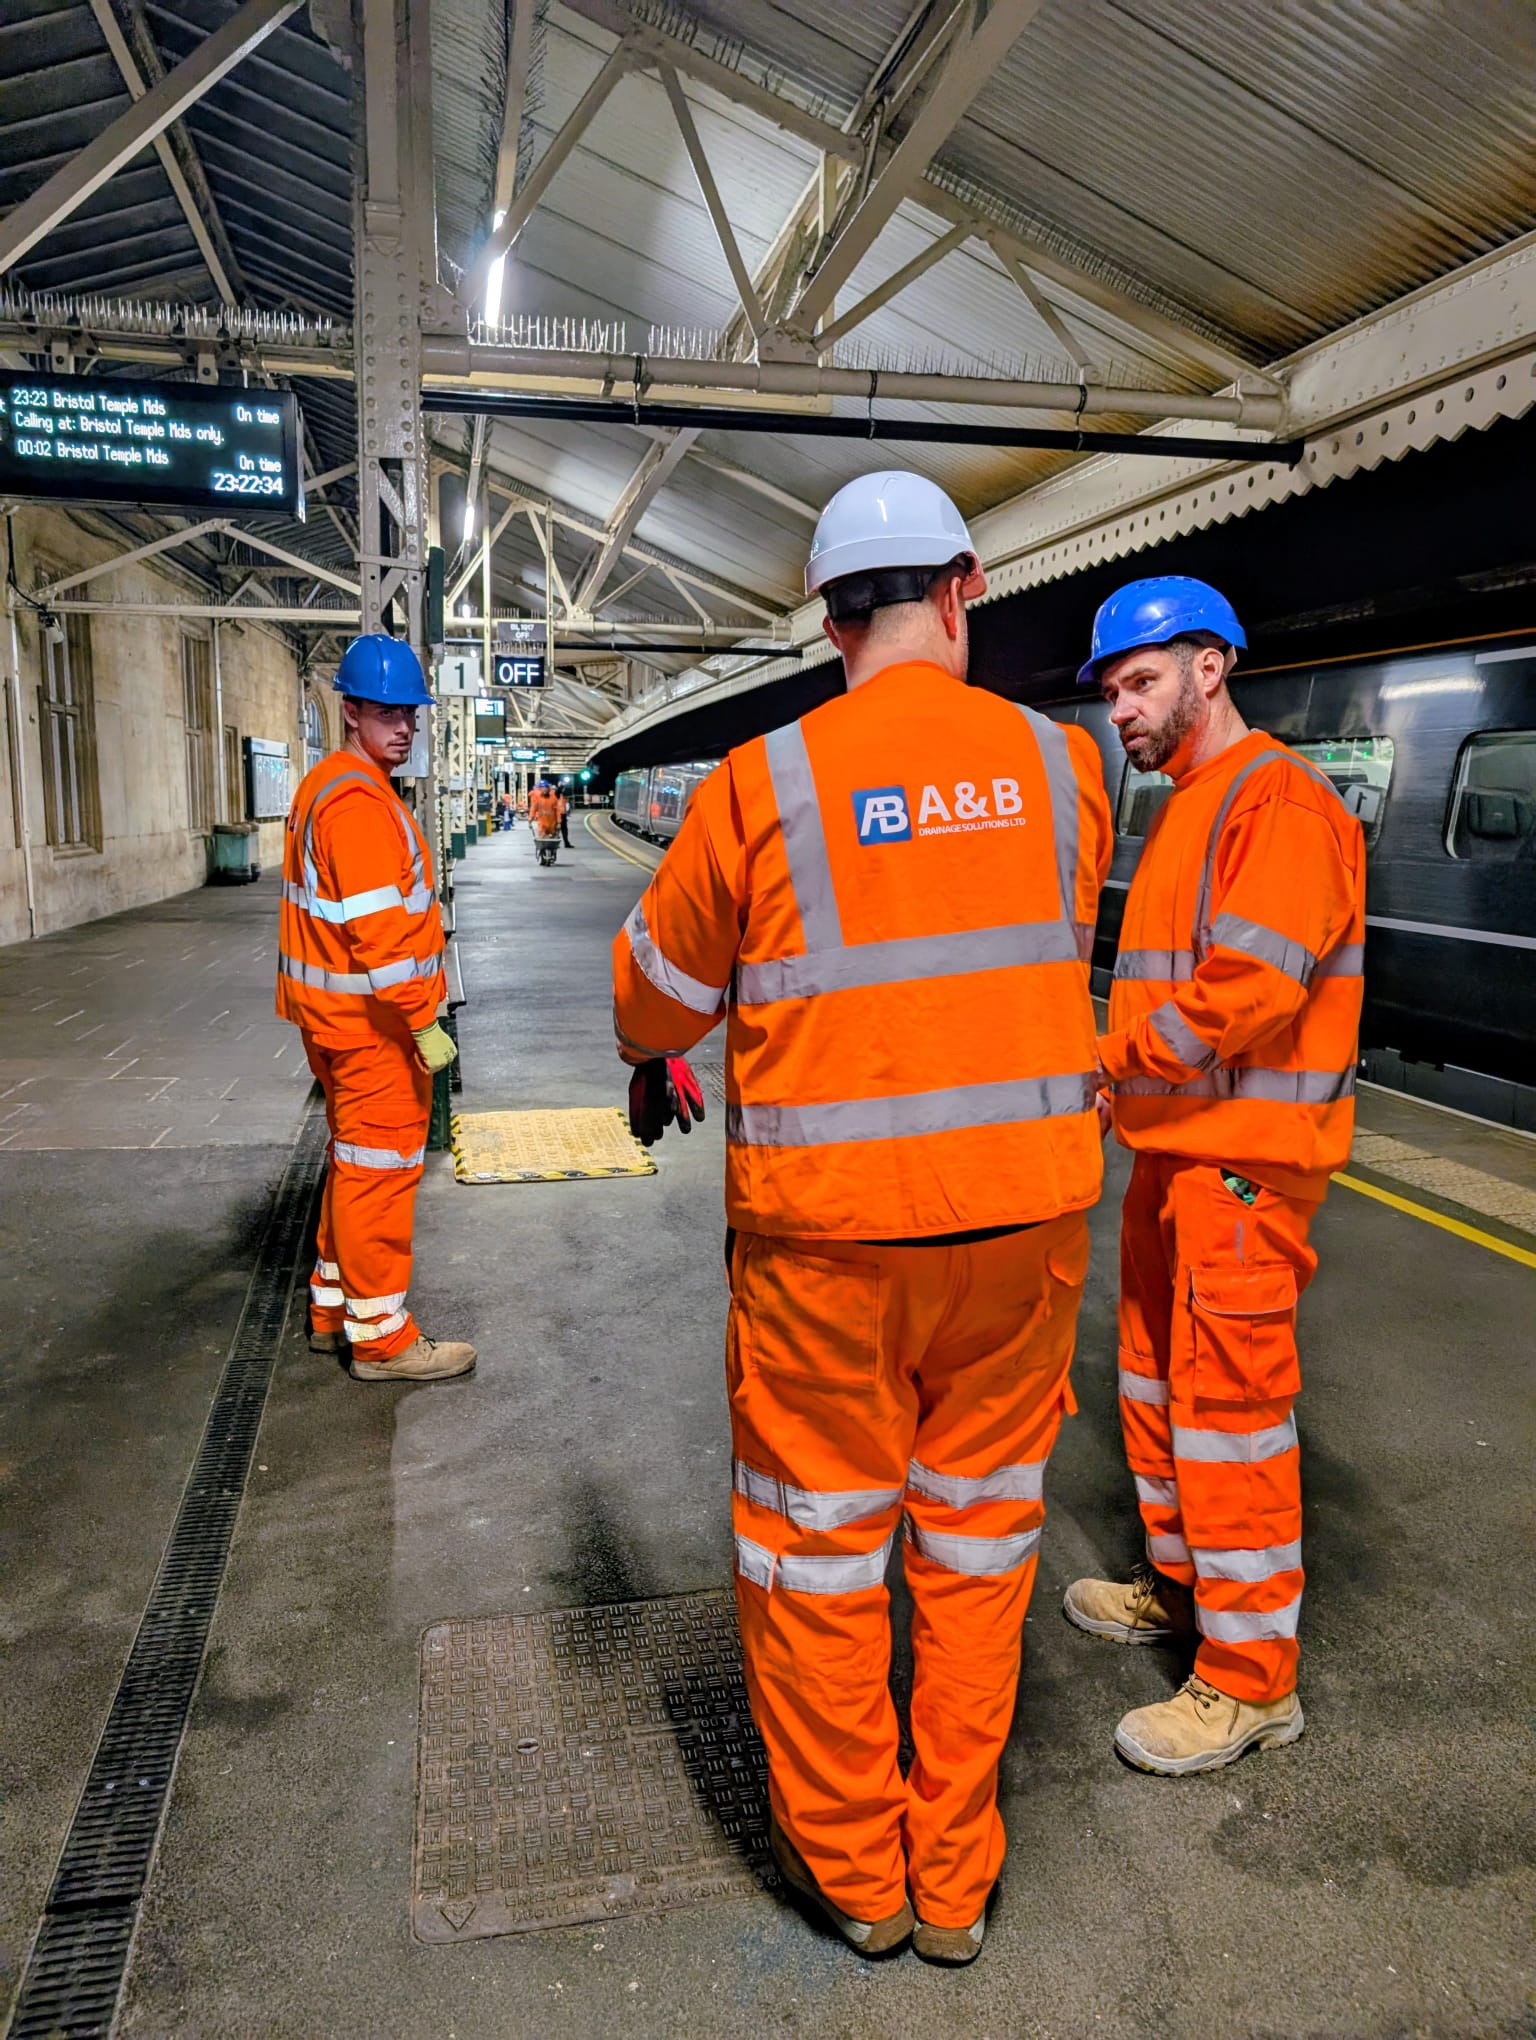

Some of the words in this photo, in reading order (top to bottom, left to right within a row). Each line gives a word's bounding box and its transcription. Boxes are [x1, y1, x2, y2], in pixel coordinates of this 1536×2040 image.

[13, 389, 47, 407] 23:23
[53, 393, 95, 411] Bristol
[100, 397, 138, 416] Temple
[143, 399, 167, 416] Mds
[237, 407, 254, 423] On
[258, 409, 280, 425] time
[15, 411, 53, 433] Calling
[58, 418, 76, 431] at:
[80, 416, 121, 435] Bristol
[126, 420, 165, 440] Temple
[169, 422, 192, 440] Mds
[196, 425, 225, 446] only.
[18, 439, 52, 457] 00:02
[57, 443, 99, 461] Bristol
[103, 446, 142, 466] Temple
[146, 447, 169, 465] Mds
[239, 455, 254, 471] On
[259, 457, 281, 473] time
[214, 473, 284, 495] 23:22:34
[454, 662, 465, 689] 1
[498, 662, 539, 684] OFF
[918, 825, 961, 837] DRAINAGE
[961, 819, 1009, 832] SOLUTIONS
[1009, 817, 1026, 827] LTD
[701, 1716, 728, 1728] OUT
